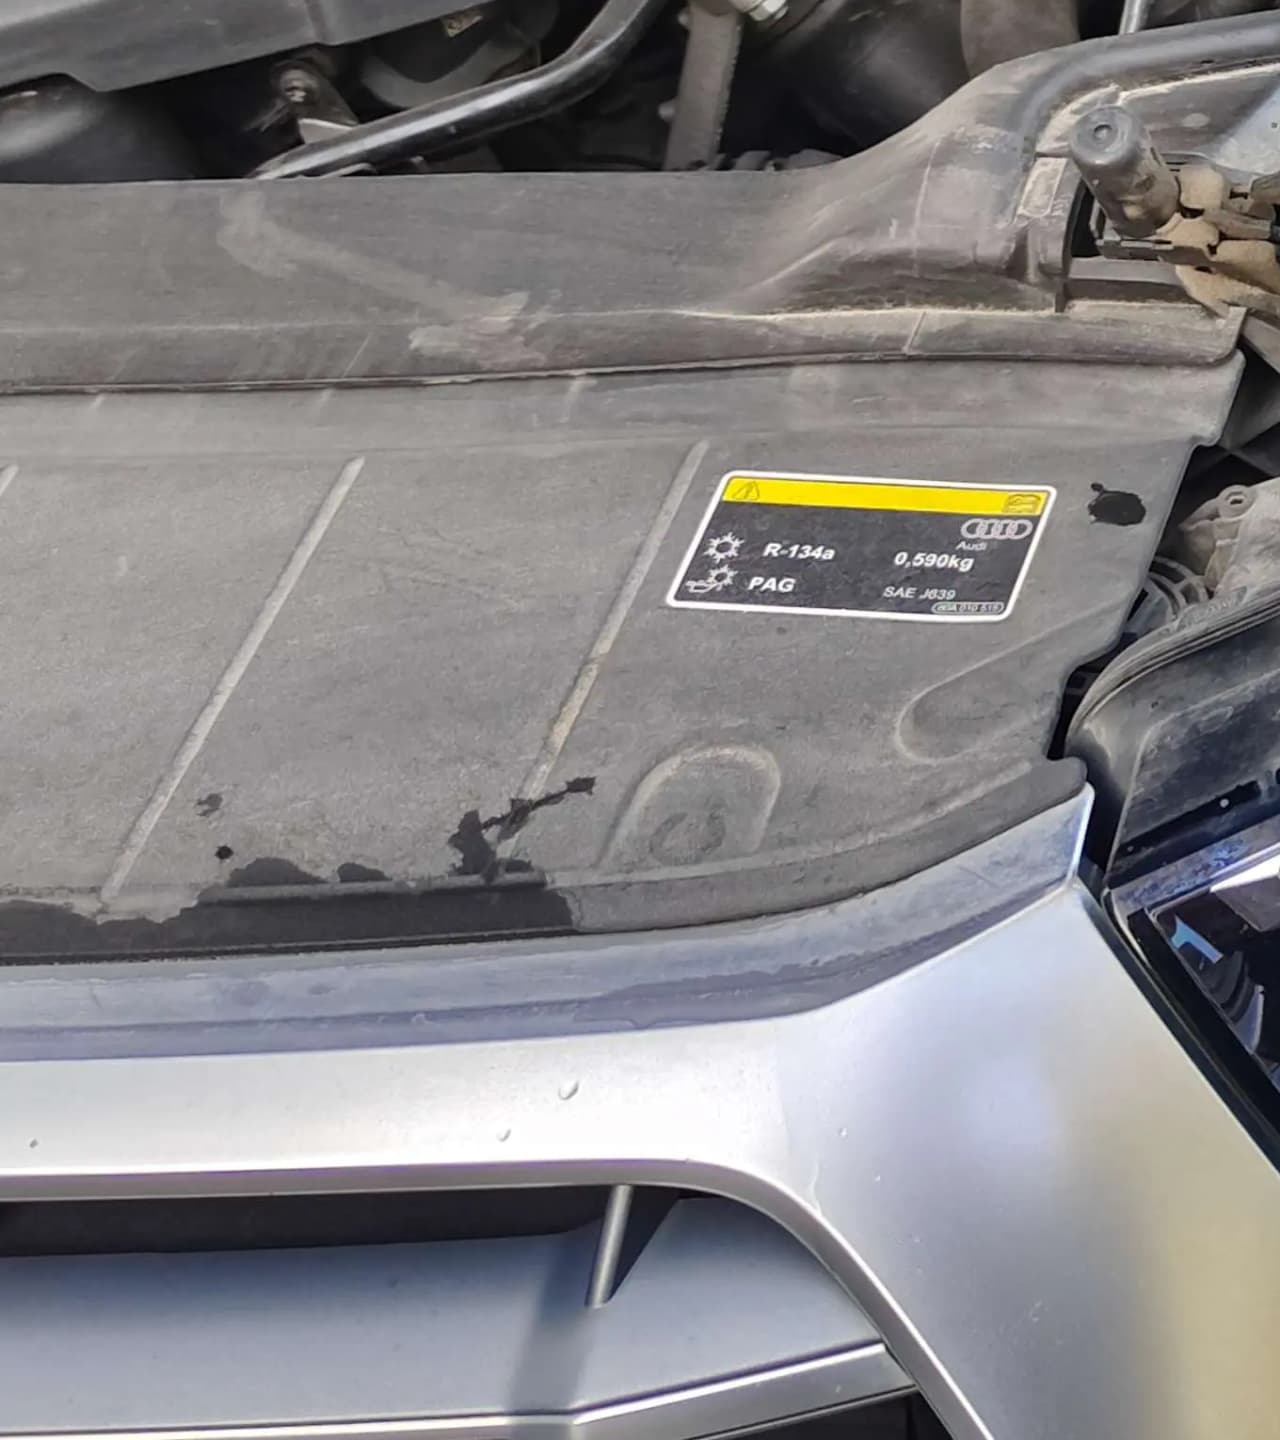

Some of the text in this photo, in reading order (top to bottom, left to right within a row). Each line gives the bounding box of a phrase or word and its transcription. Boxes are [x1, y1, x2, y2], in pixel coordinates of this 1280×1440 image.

[763, 542, 836, 560] R-134a
[955, 541, 987, 551] Audi
[894, 551, 974, 573] 0,590kg
[747, 576, 796, 593] PAG
[883, 586, 956, 601] SAE J639
